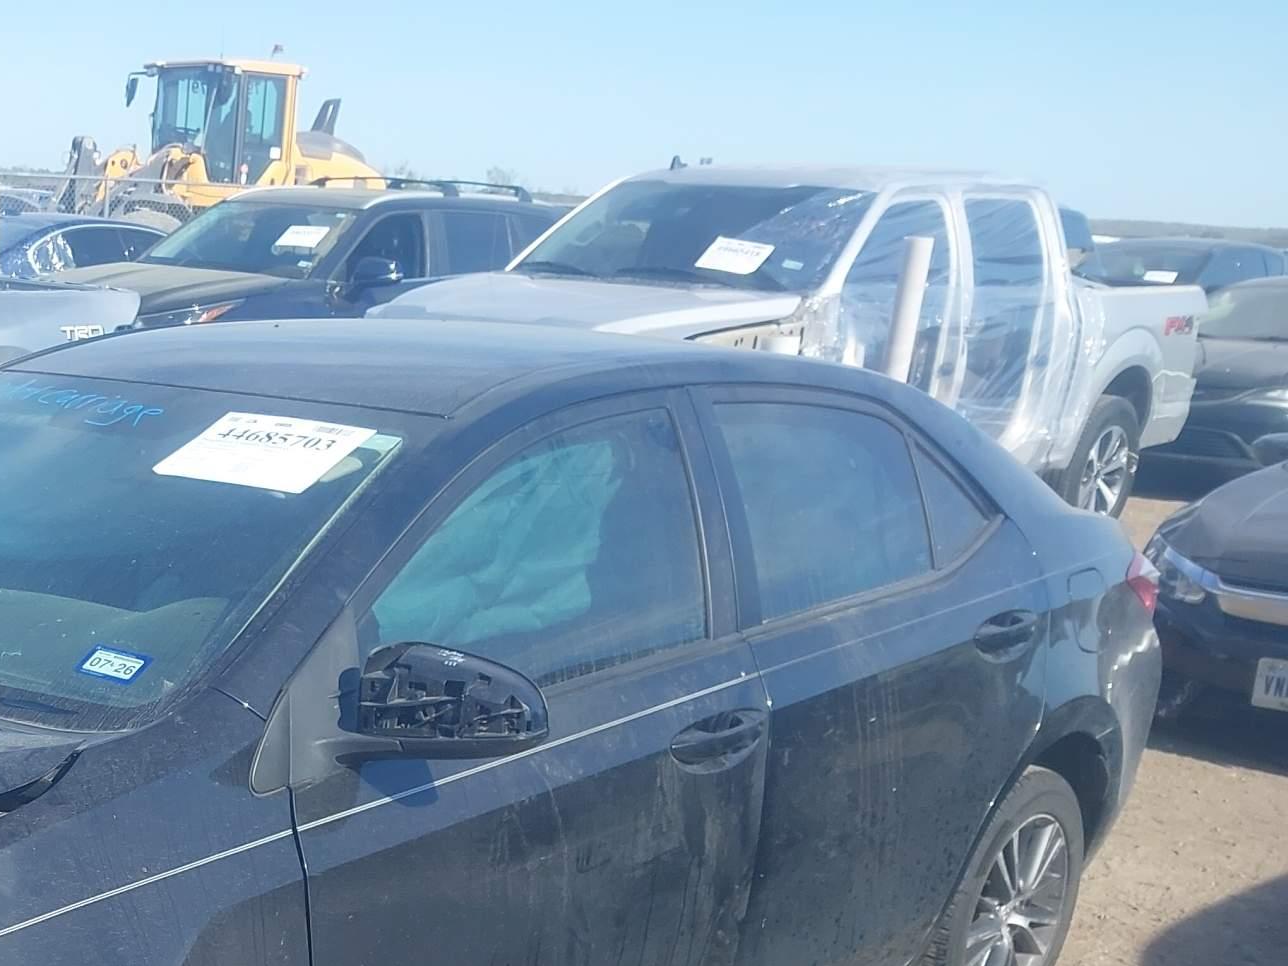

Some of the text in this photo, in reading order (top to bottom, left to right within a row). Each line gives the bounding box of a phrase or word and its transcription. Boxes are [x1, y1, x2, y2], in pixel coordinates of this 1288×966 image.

[59, 324, 104, 341] TRD
[217, 427, 337, 451] 44685703
[1264, 675, 1288, 698] VN
